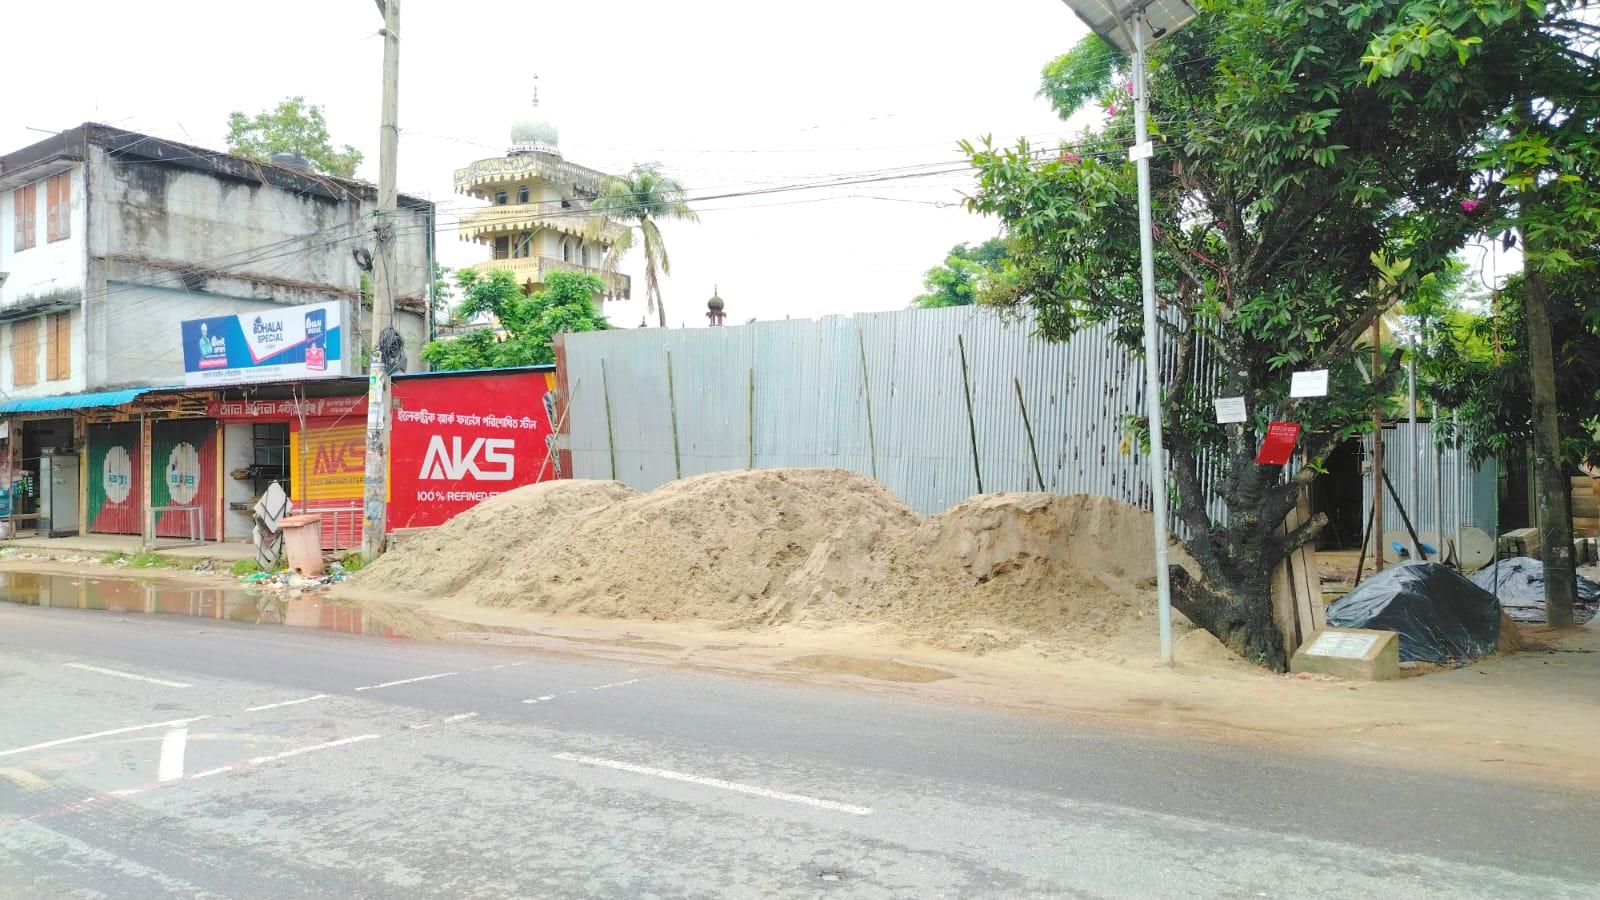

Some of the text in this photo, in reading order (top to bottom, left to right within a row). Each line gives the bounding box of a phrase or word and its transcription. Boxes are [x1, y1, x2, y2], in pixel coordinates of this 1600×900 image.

[257, 333, 283, 343] SPECIAL
[437, 412, 455, 425] আর্ক
[482, 413, 519, 429] পরিশোধিত
[312, 440, 366, 476] AKS
[418, 434, 515, 481] AKS
[417, 491, 445, 502] 100%
[447, 491, 489, 502] REFINED
